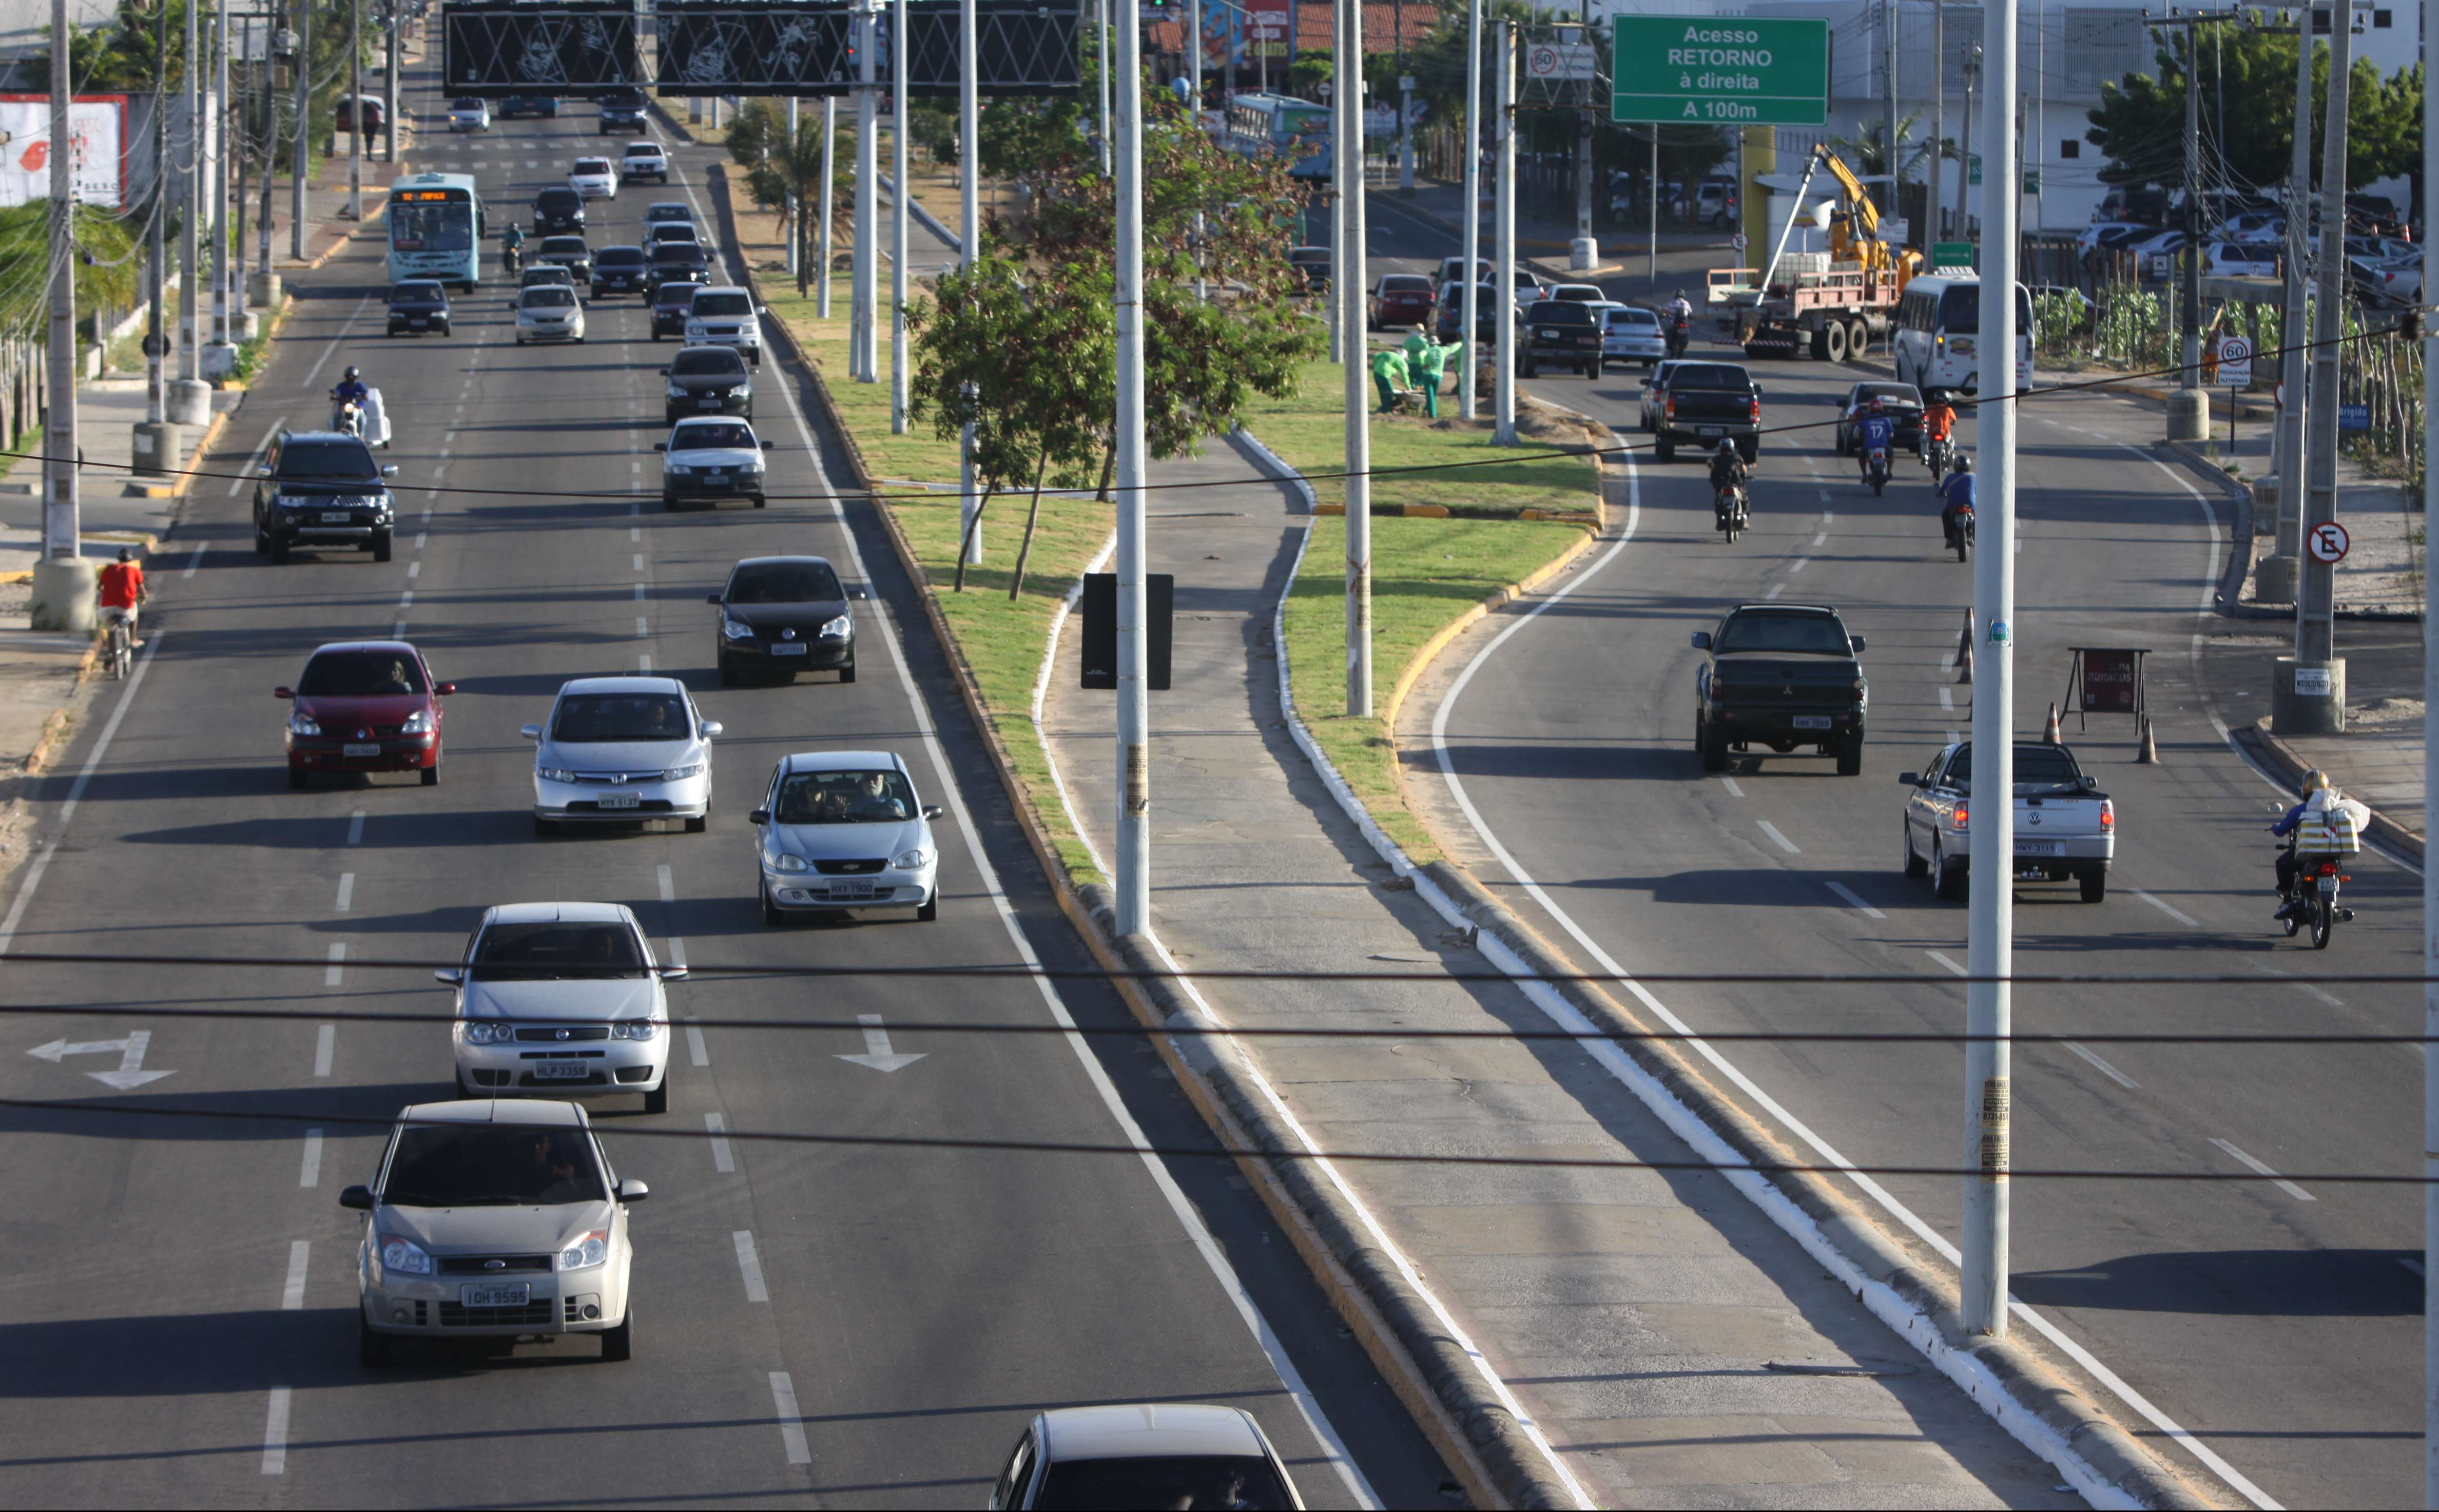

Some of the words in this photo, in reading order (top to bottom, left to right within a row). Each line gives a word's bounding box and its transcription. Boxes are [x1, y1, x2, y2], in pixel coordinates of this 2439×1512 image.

[1683, 26, 1758, 43] Acesso
[1668, 49, 1772, 67] RETORNO
[1680, 71, 1691, 88] à
[1697, 72, 1759, 90] direita
[1683, 101, 1698, 118] A
[1705, 103, 1757, 118] 100m
[2227, 345, 2243, 357] 60
[2321, 530, 2336, 553] E
[2087, 672, 2131, 683] BURACOS
[831, 884, 846, 893] HXY
[851, 884, 872, 892] 7900
[537, 1067, 557, 1076] HLP
[468, 1292, 490, 1304] IOH
[494, 1291, 526, 1304] 9595
